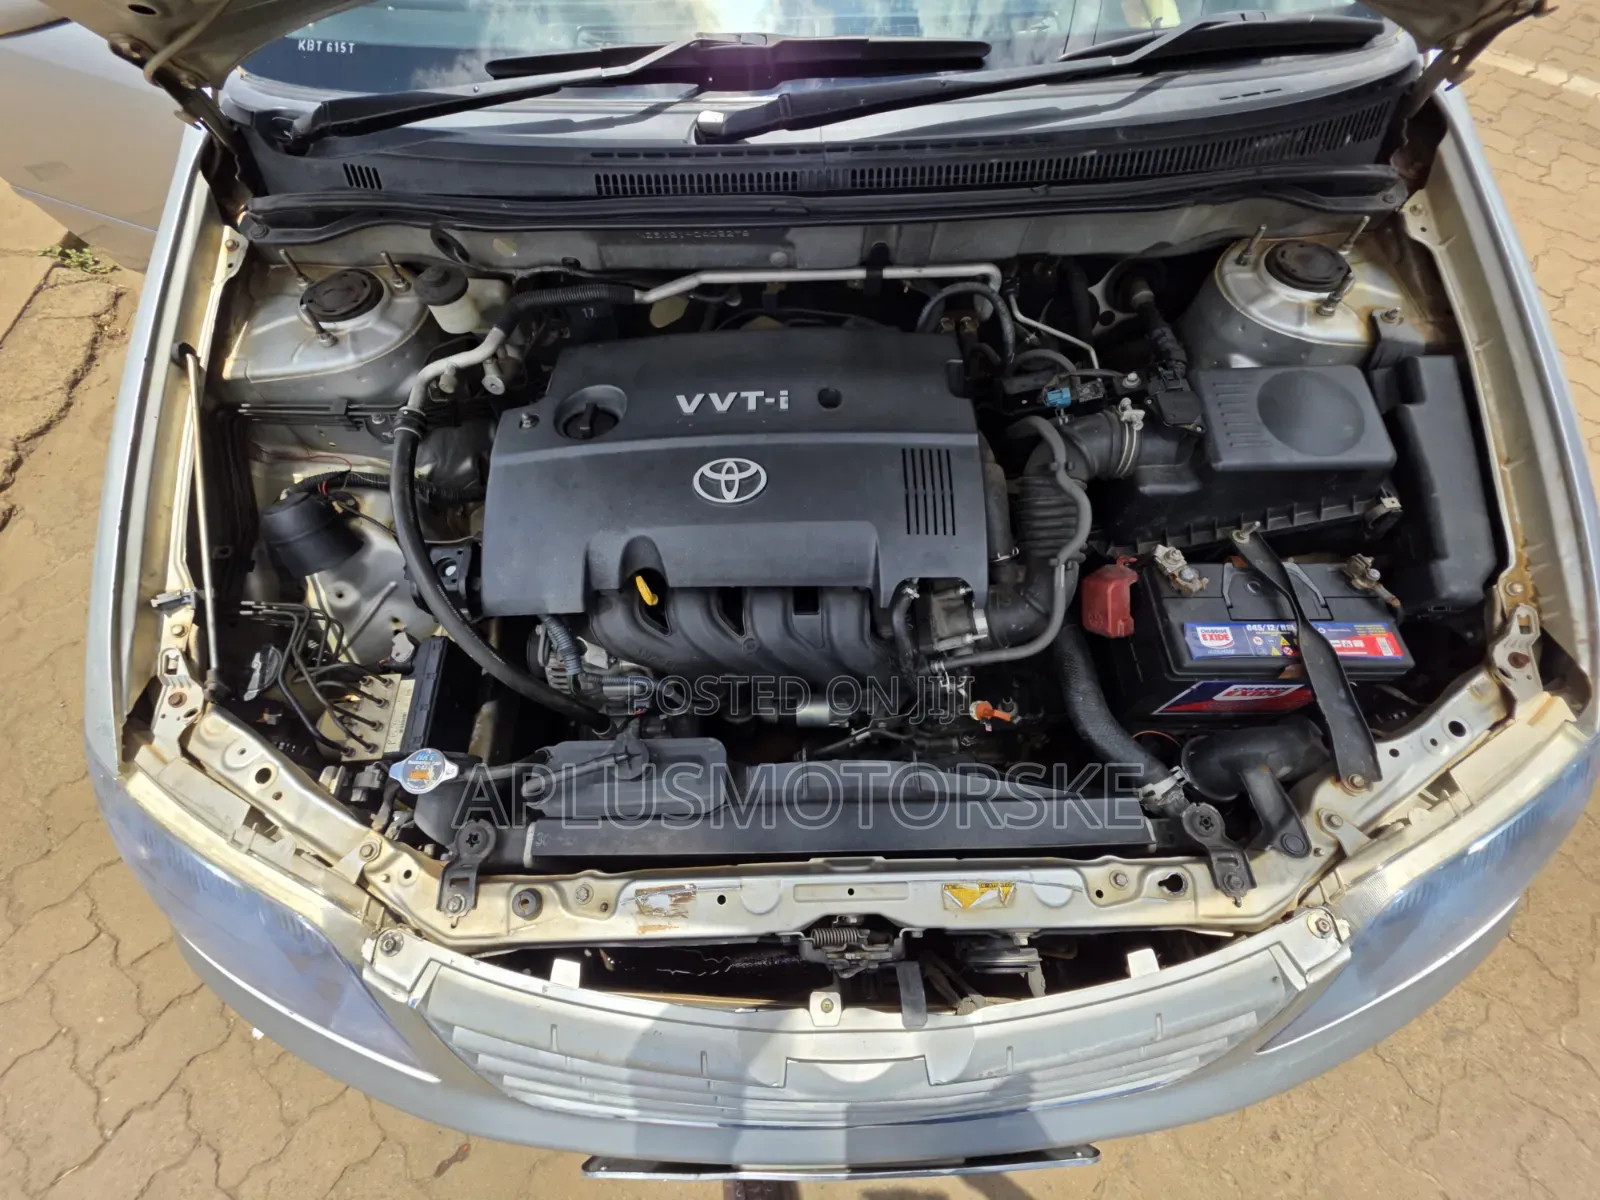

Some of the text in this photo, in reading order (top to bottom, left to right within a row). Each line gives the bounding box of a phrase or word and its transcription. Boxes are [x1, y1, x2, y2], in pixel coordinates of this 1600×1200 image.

[297, 39, 355, 54] KBT 615T
[675, 389, 789, 415] VVT-i
[1201, 633, 1230, 641] EXIDE
